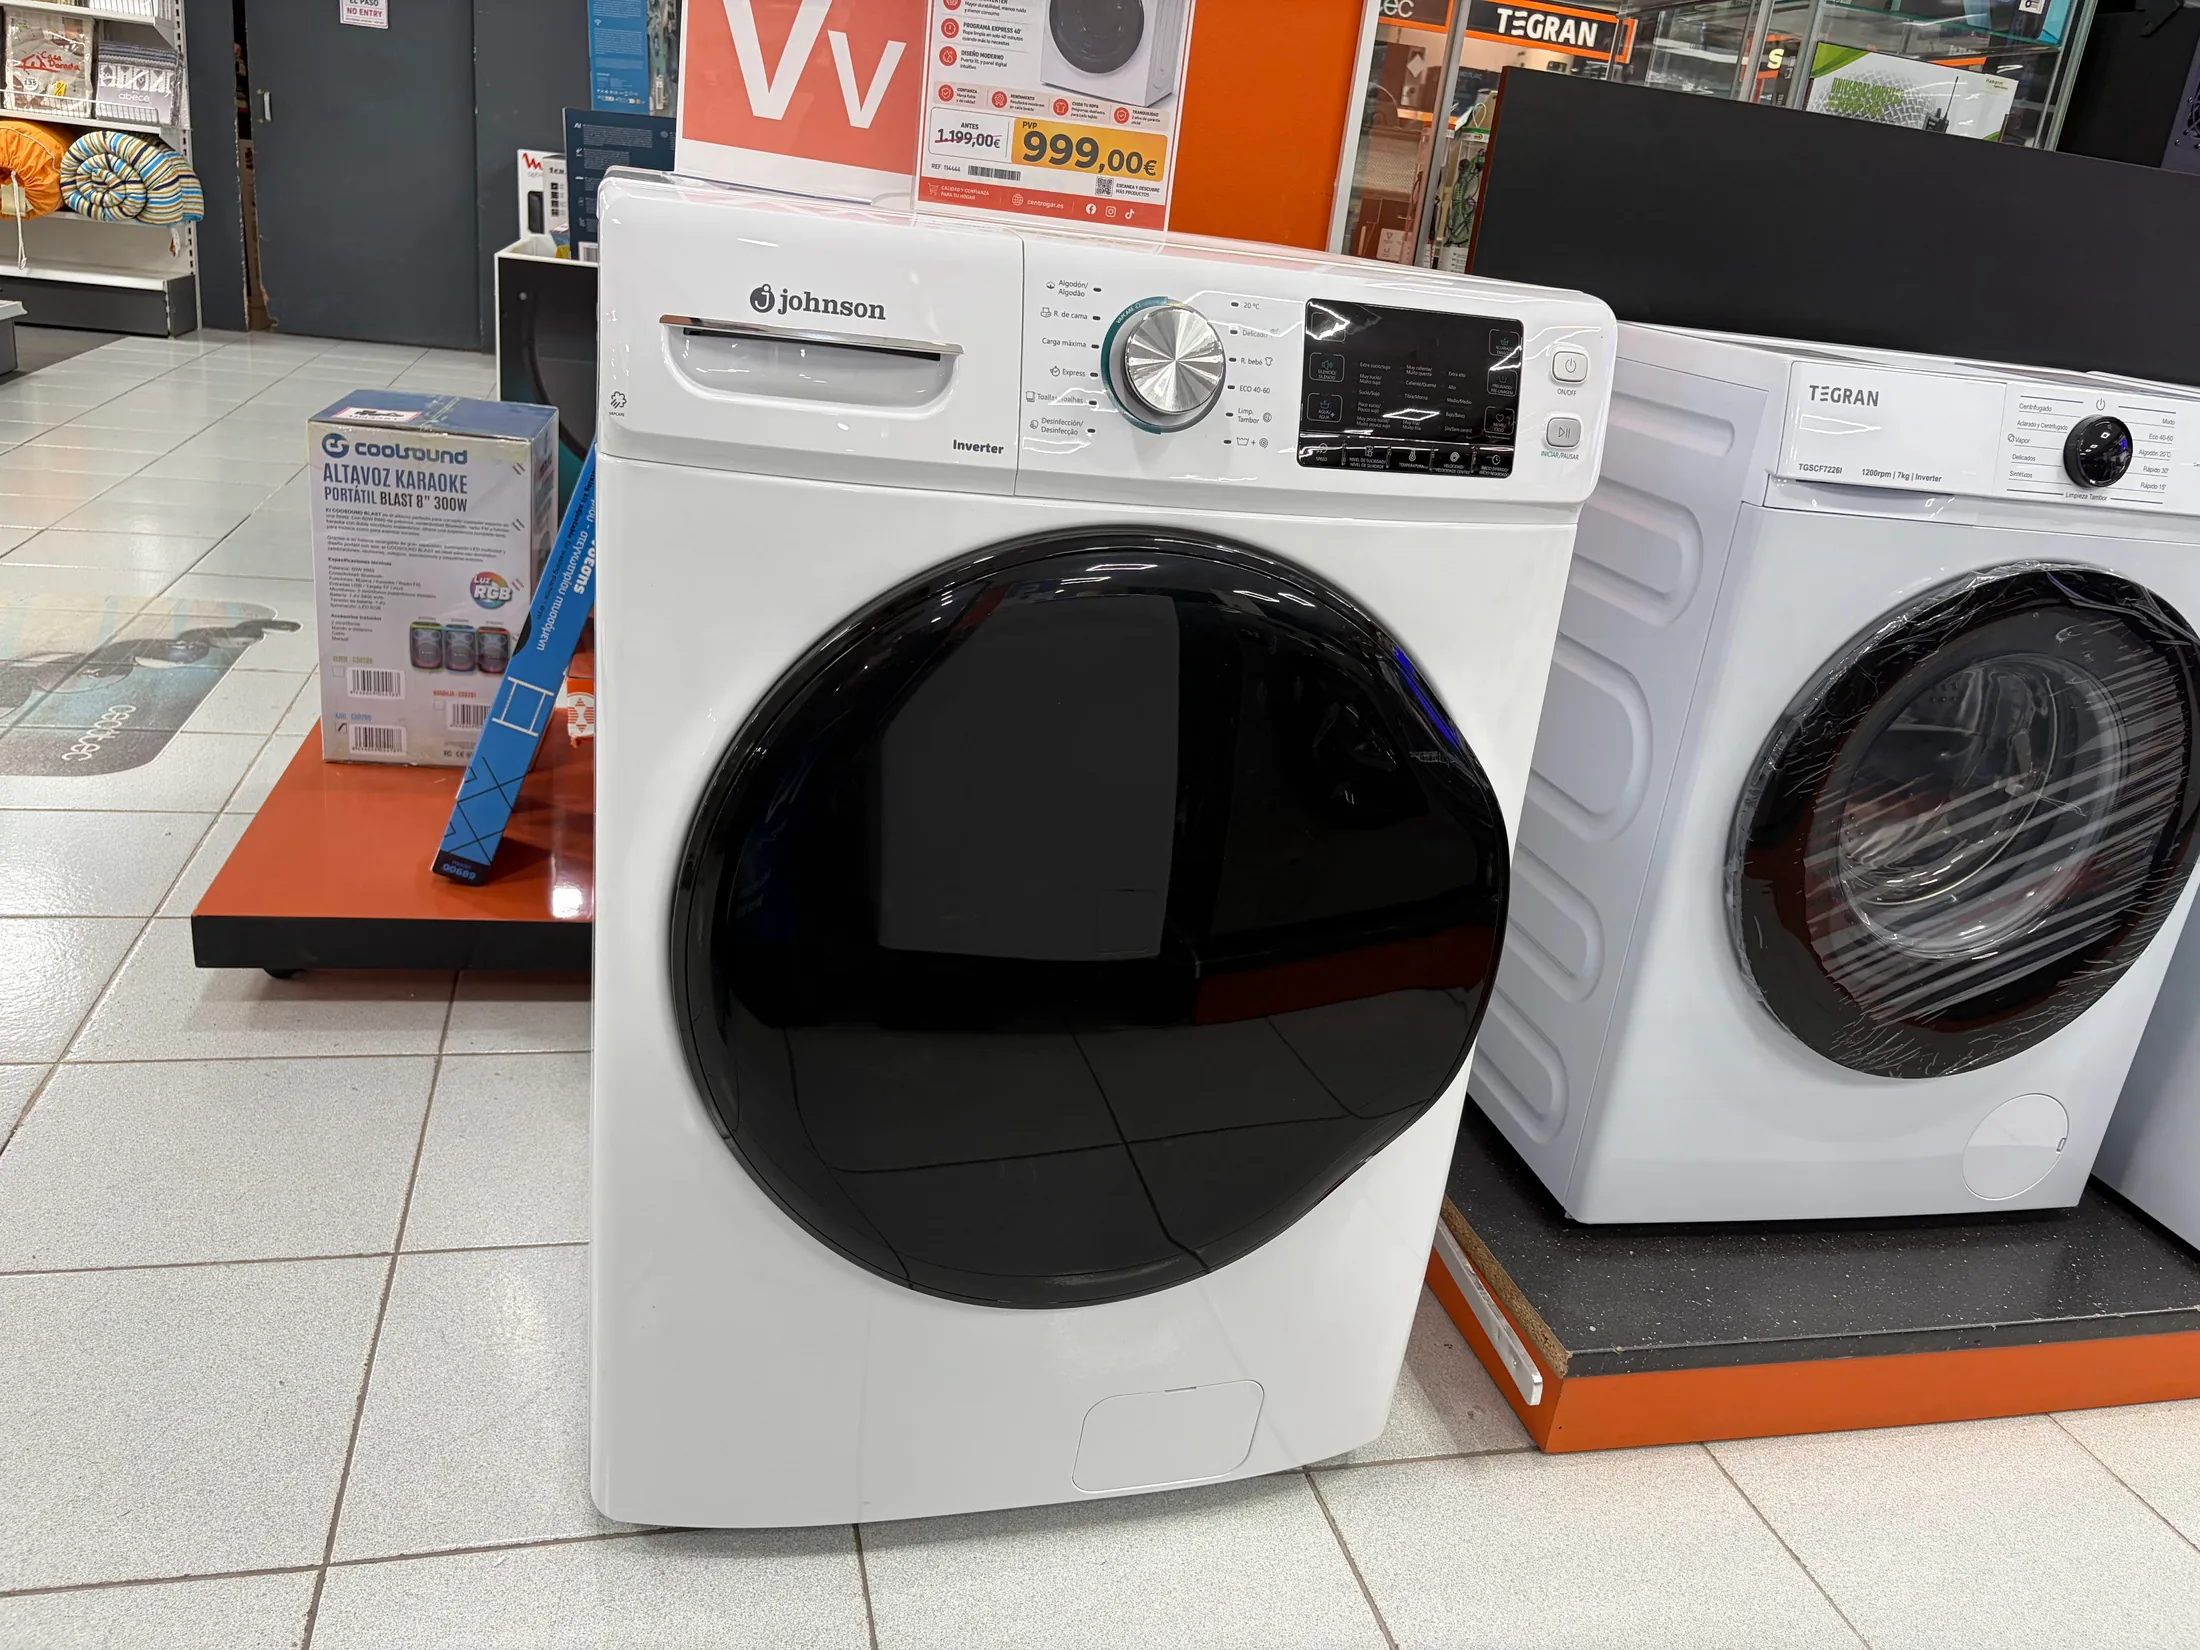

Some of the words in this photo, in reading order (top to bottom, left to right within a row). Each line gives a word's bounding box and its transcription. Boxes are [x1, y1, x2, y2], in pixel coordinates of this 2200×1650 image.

[347, 7, 357, 15] NO
[360, 8, 382, 17] ENTRY
[963, 22, 990, 30] PROGRAMA
[1497, 8, 1598, 47] TEGRAN
[41, 51, 62, 61] Casa
[49, 60, 80, 71] Dorada
[961, 122, 979, 130] ANTES
[1022, 121, 1037, 129] PVP
[936, 128, 1000, 148] 1.199,00€
[1023, 130, 1157, 176] 999,00€
[965, 188, 989, 196] CONFIANZA
[1027, 199, 1064, 209] centrogar.es
[1058, 280, 1088, 289] Algodón/
[1058, 289, 1085, 297] Algodão
[778, 288, 886, 320] johnson
[1242, 330, 1268, 338] Delicado
[1042, 338, 1061, 346] Carga
[1062, 339, 1087, 348] máxima
[1062, 369, 1085, 377] Express
[1253, 386, 1270, 394] 40-60
[1557, 388, 1576, 396] ON/OFF
[1809, 385, 1879, 407] TEGRAN
[2019, 403, 2052, 412] Centrifugado
[1041, 417, 1084, 427] Desinfección/
[1238, 416, 1259, 424] Tambor
[2017, 420, 2036, 428] Aclarado
[2040, 422, 2068, 431] Centrifugado
[1041, 426, 1078, 436] Desinfecção
[953, 439, 1004, 454] Inverter
[355, 442, 468, 465] coolsound
[1541, 450, 1579, 460] INICIAR/PAUSAR
[2012, 454, 2036, 462] Delicados
[2139, 449, 2158, 458] Algodón
[1862, 468, 1892, 479] 1200rpm
[1897, 472, 1910, 481] 7kg
[1915, 474, 1942, 482] Inverter
[2009, 470, 2032, 479] Sintéticos
[2143, 466, 2160, 474] Rápido
[323, 463, 391, 487] ALTAVOZ
[396, 469, 468, 494] KARAOKE
[2140, 482, 2157, 490] Rápido
[325, 485, 377, 504] PORTÁTIL
[380, 492, 413, 508] BLAST
[434, 496, 467, 512] 300W
[581, 493, 589, 503] kit
[2065, 492, 2088, 500] Limpieza
[567, 504, 584, 539] adjustable
[474, 576, 492, 584] Luz
[474, 586, 512, 601] RGB
